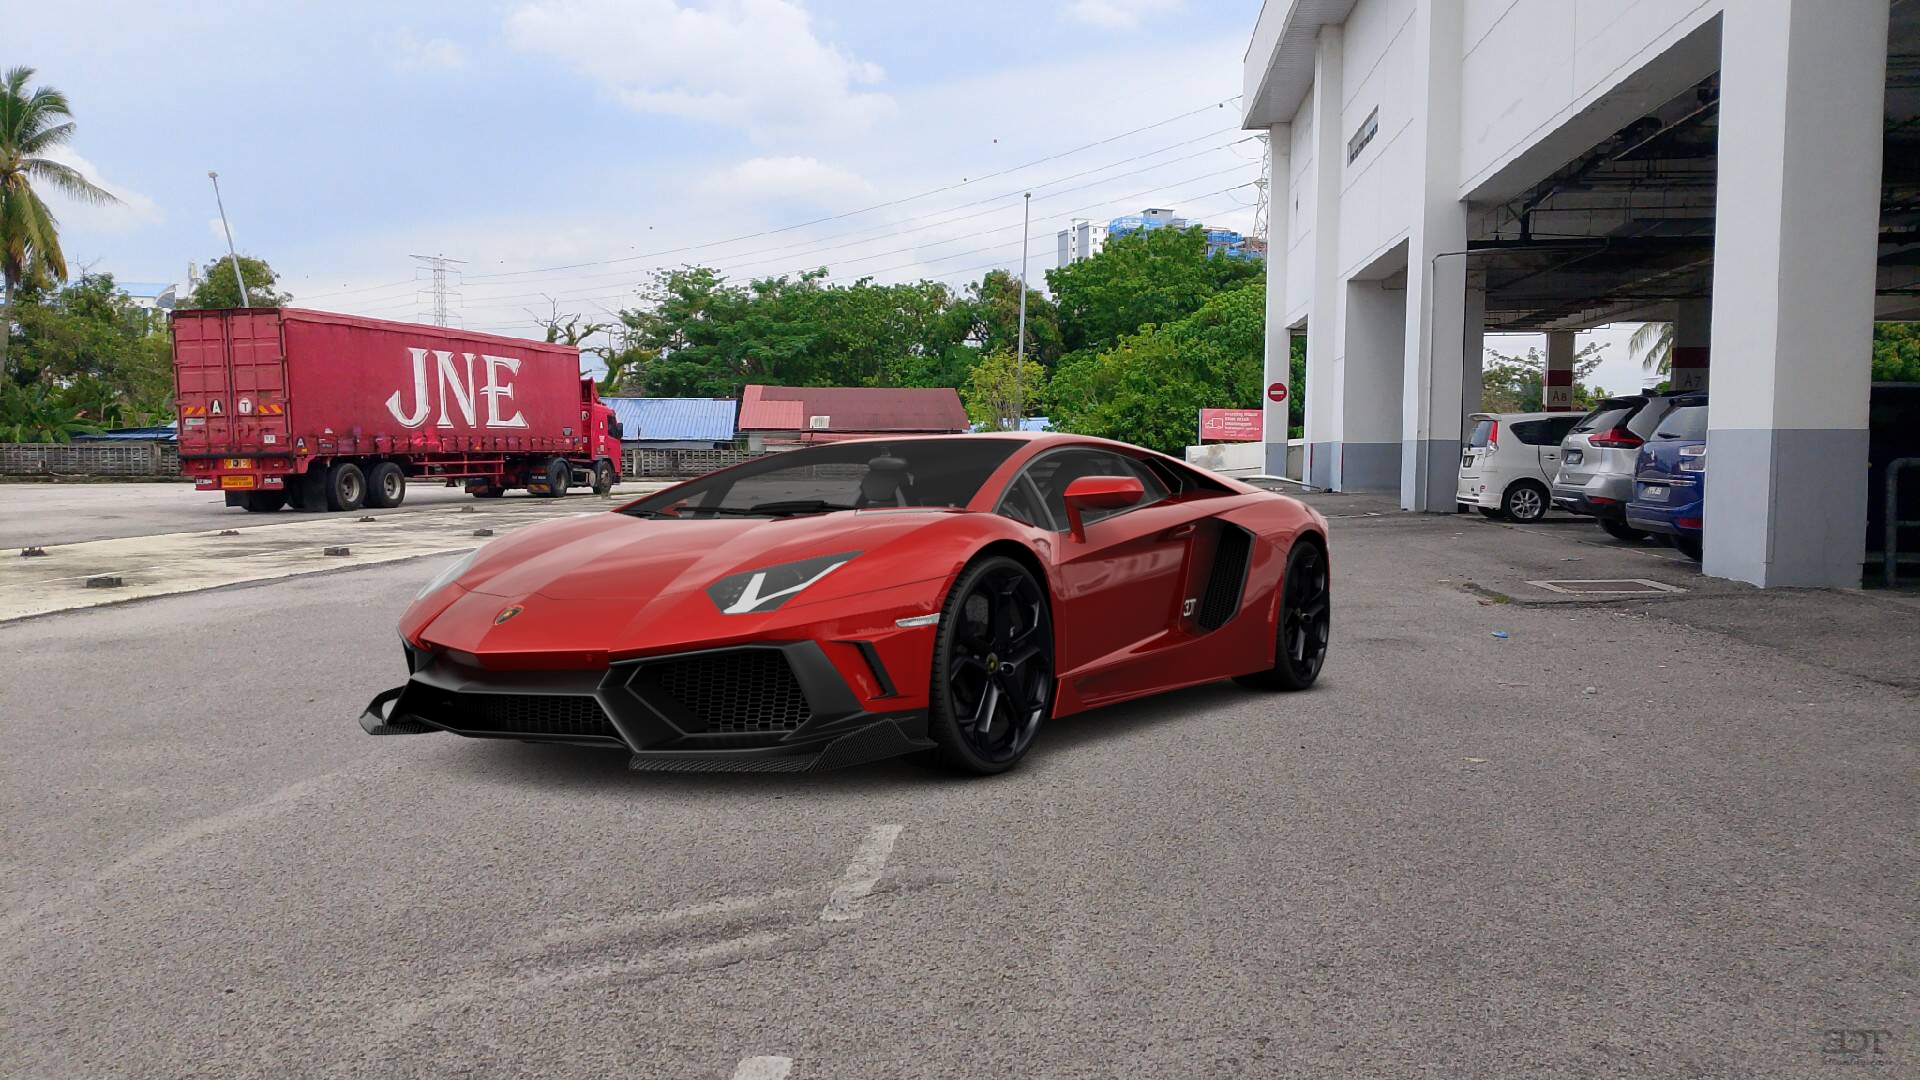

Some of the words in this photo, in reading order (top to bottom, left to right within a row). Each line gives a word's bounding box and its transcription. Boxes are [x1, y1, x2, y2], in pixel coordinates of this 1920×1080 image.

[385, 347, 529, 429] JNE
[1552, 390, 1567, 402] A8
[211, 400, 221, 414] A
[241, 402, 249, 412] T
[296, 438, 305, 448] A
